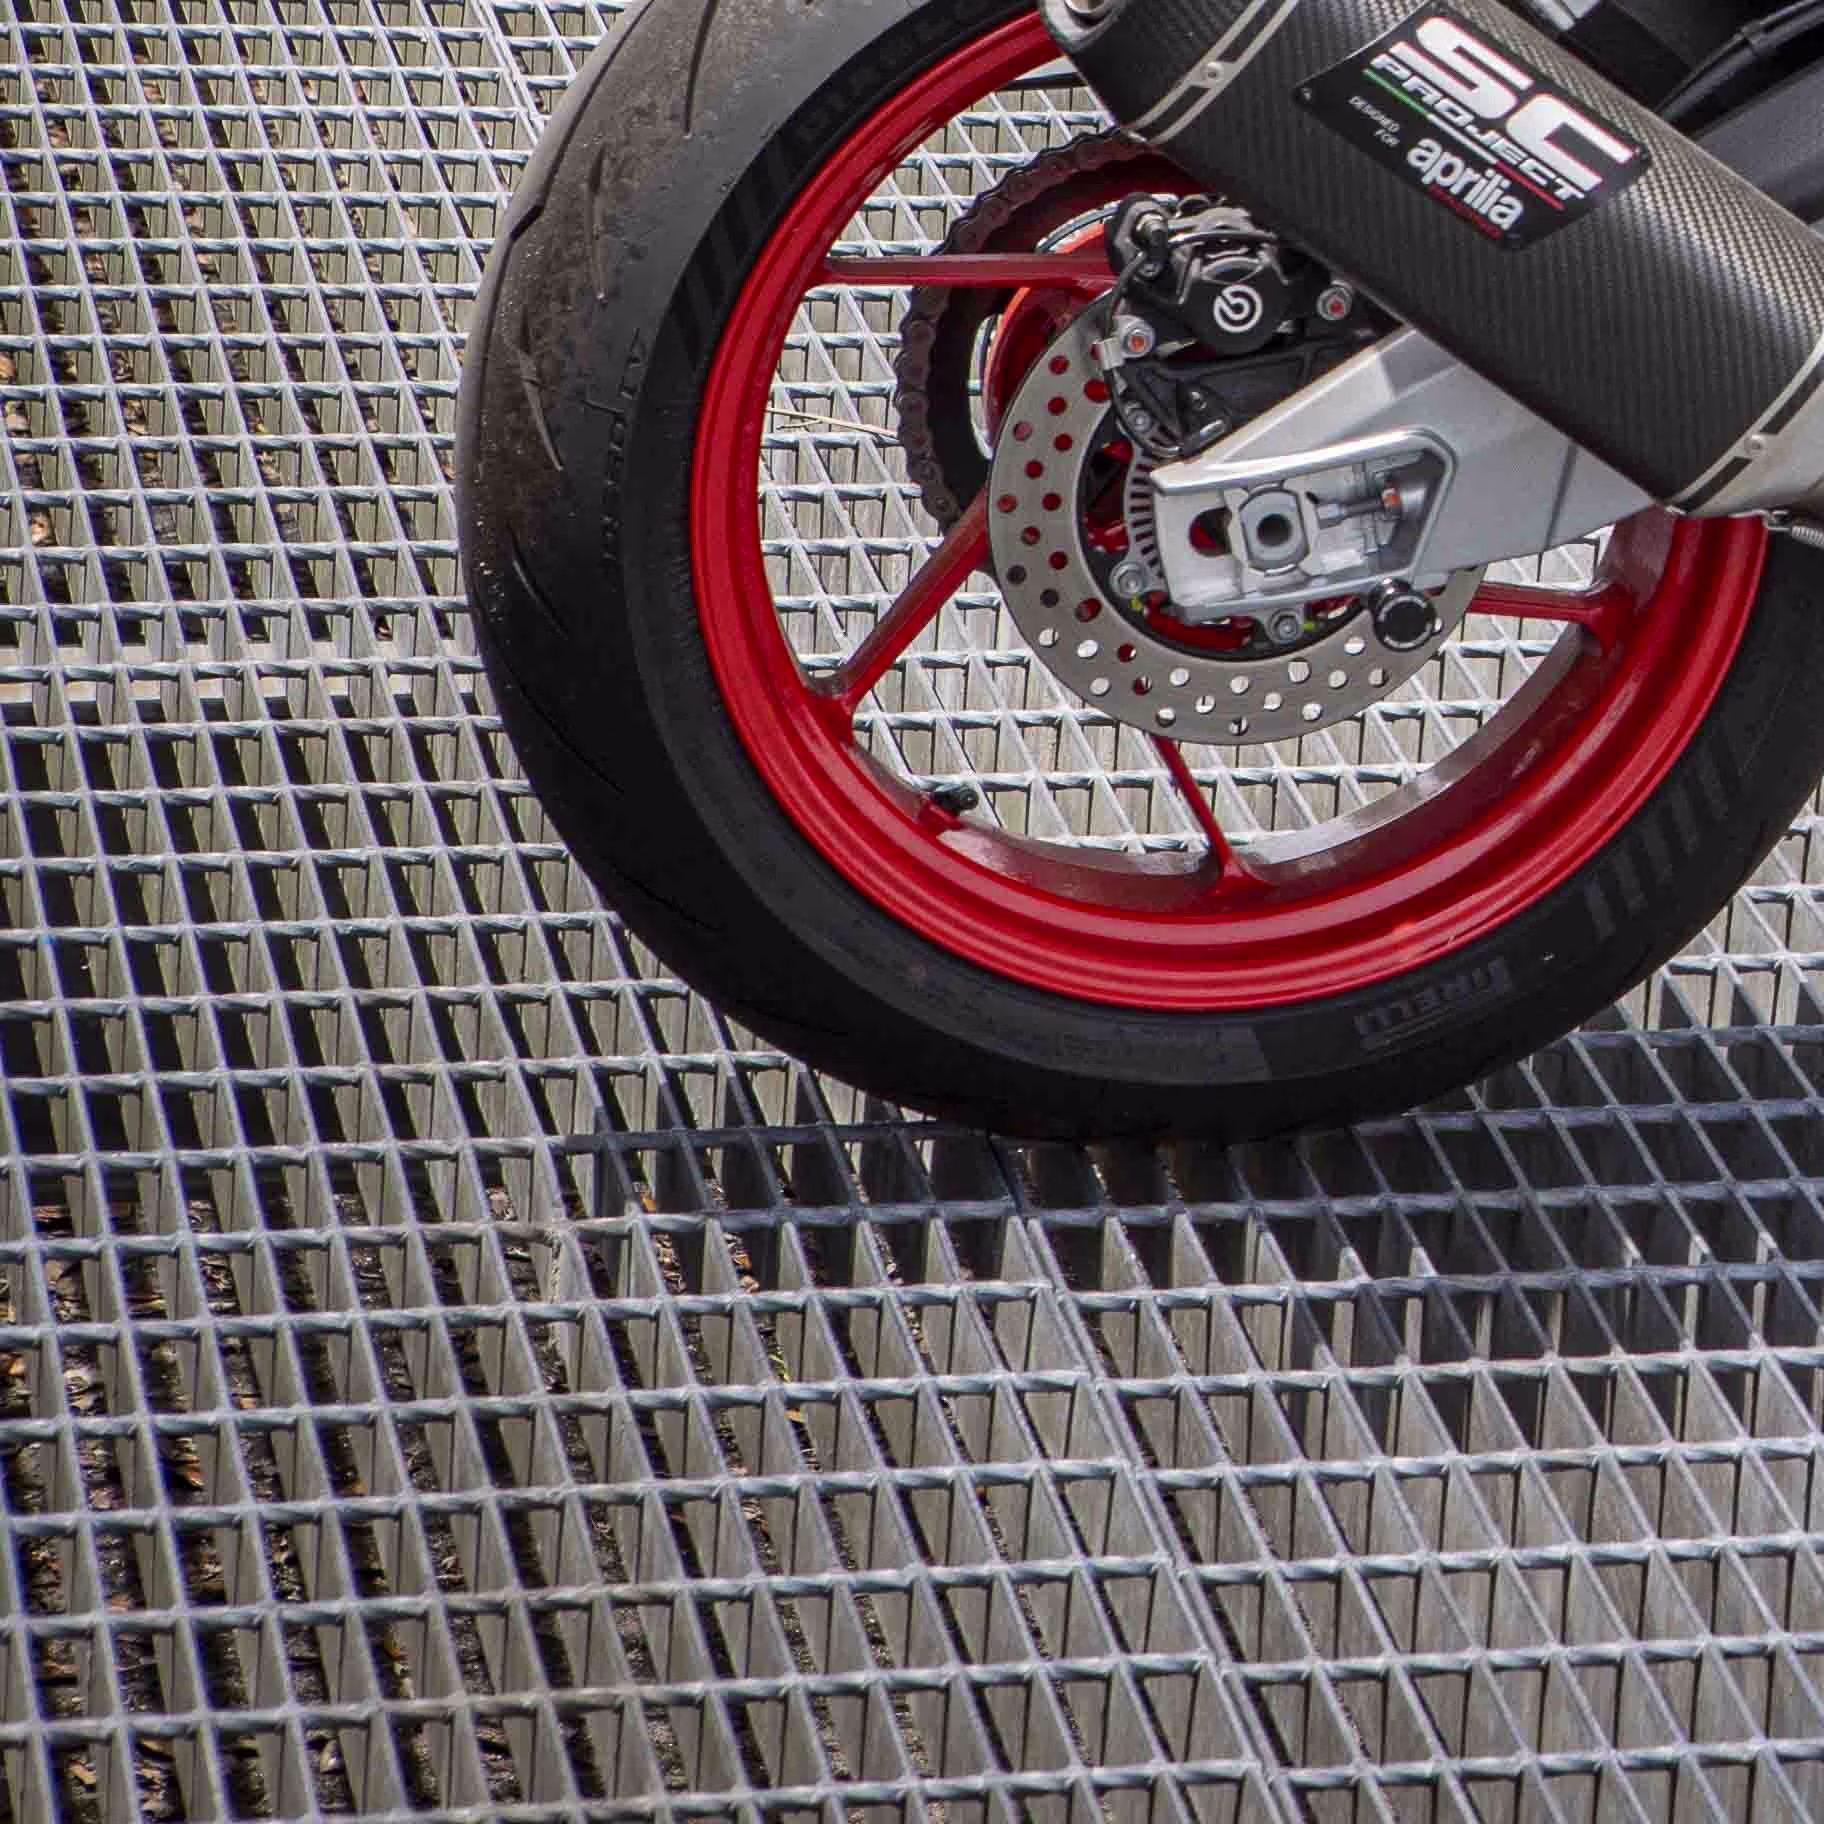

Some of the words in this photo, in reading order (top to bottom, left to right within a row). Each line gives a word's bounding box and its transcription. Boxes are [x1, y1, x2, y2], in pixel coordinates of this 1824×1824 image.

[1369, 53, 1585, 199] PROJECT
[1389, 16, 1634, 192] SC
[1407, 138, 1523, 230] aprilia
